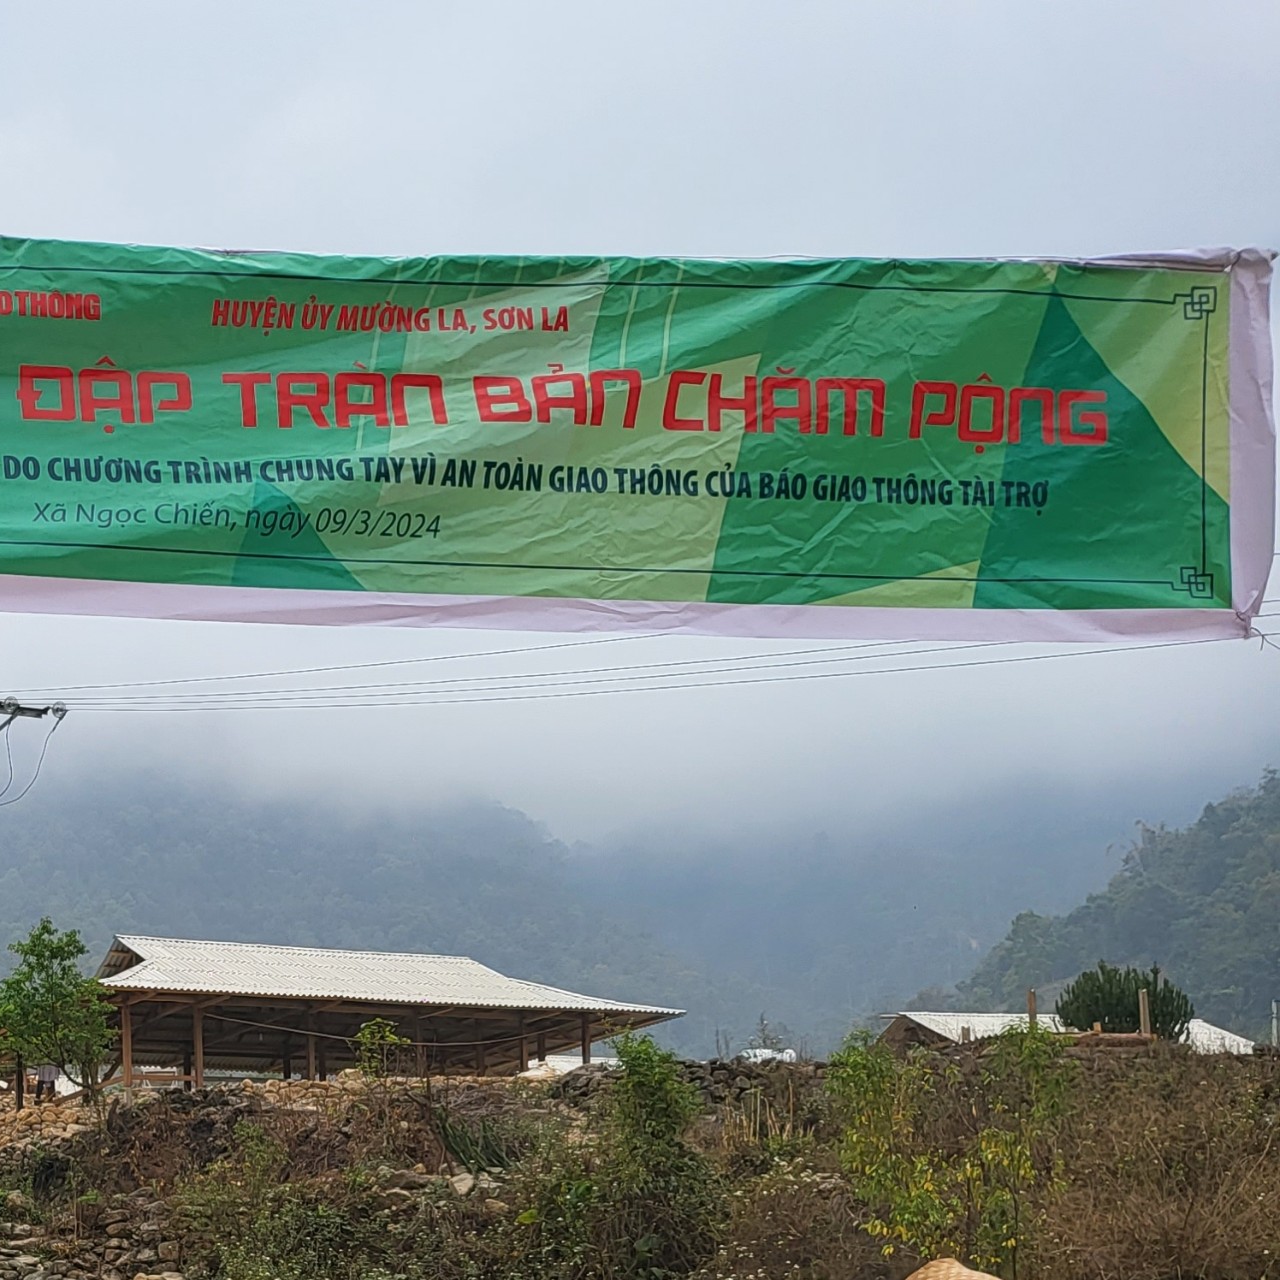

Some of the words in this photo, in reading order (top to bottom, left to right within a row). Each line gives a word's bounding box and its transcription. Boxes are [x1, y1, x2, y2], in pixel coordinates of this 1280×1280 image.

[212, 296, 295, 336] HUYỆN
[301, 295, 334, 330] ỦY
[337, 300, 430, 333] MƯỜNG
[438, 307, 476, 334] LA,
[484, 306, 533, 330] SƠN
[541, 306, 569, 331] LA
[16, 355, 193, 434] ĐẬP
[222, 360, 448, 428] TRÀN
[473, 363, 641, 429] BẢN
[662, 366, 886, 437] CHĂM
[909, 372, 1108, 454] PỘNG
[4, 454, 40, 481] DO
[47, 456, 162, 484] CHƯƠNG
[167, 455, 253, 485] TRÌNH
[260, 457, 353, 483] CHUNG
[358, 456, 406, 485] TAY
[411, 452, 438, 486] VÌ
[440, 460, 475, 488] AN
[482, 453, 543, 492] TOÀN
[548, 466, 608, 494] GIAO
[613, 464, 698, 497] THÔNG
[705, 462, 752, 499] CỦA
[759, 466, 806, 500] BÁO
[812, 474, 867, 502] GIAO
[871, 472, 954, 506] THÔNG
[958, 474, 996, 508] TÀI
[1001, 479, 1049, 516] TRỢ
[33, 502, 67, 523] Xã
[76, 503, 147, 531] Ngọc
[154, 500, 237, 531] Chiến,
[244, 504, 312, 539] ngày
[315, 507, 441, 539] 09/3/2024
